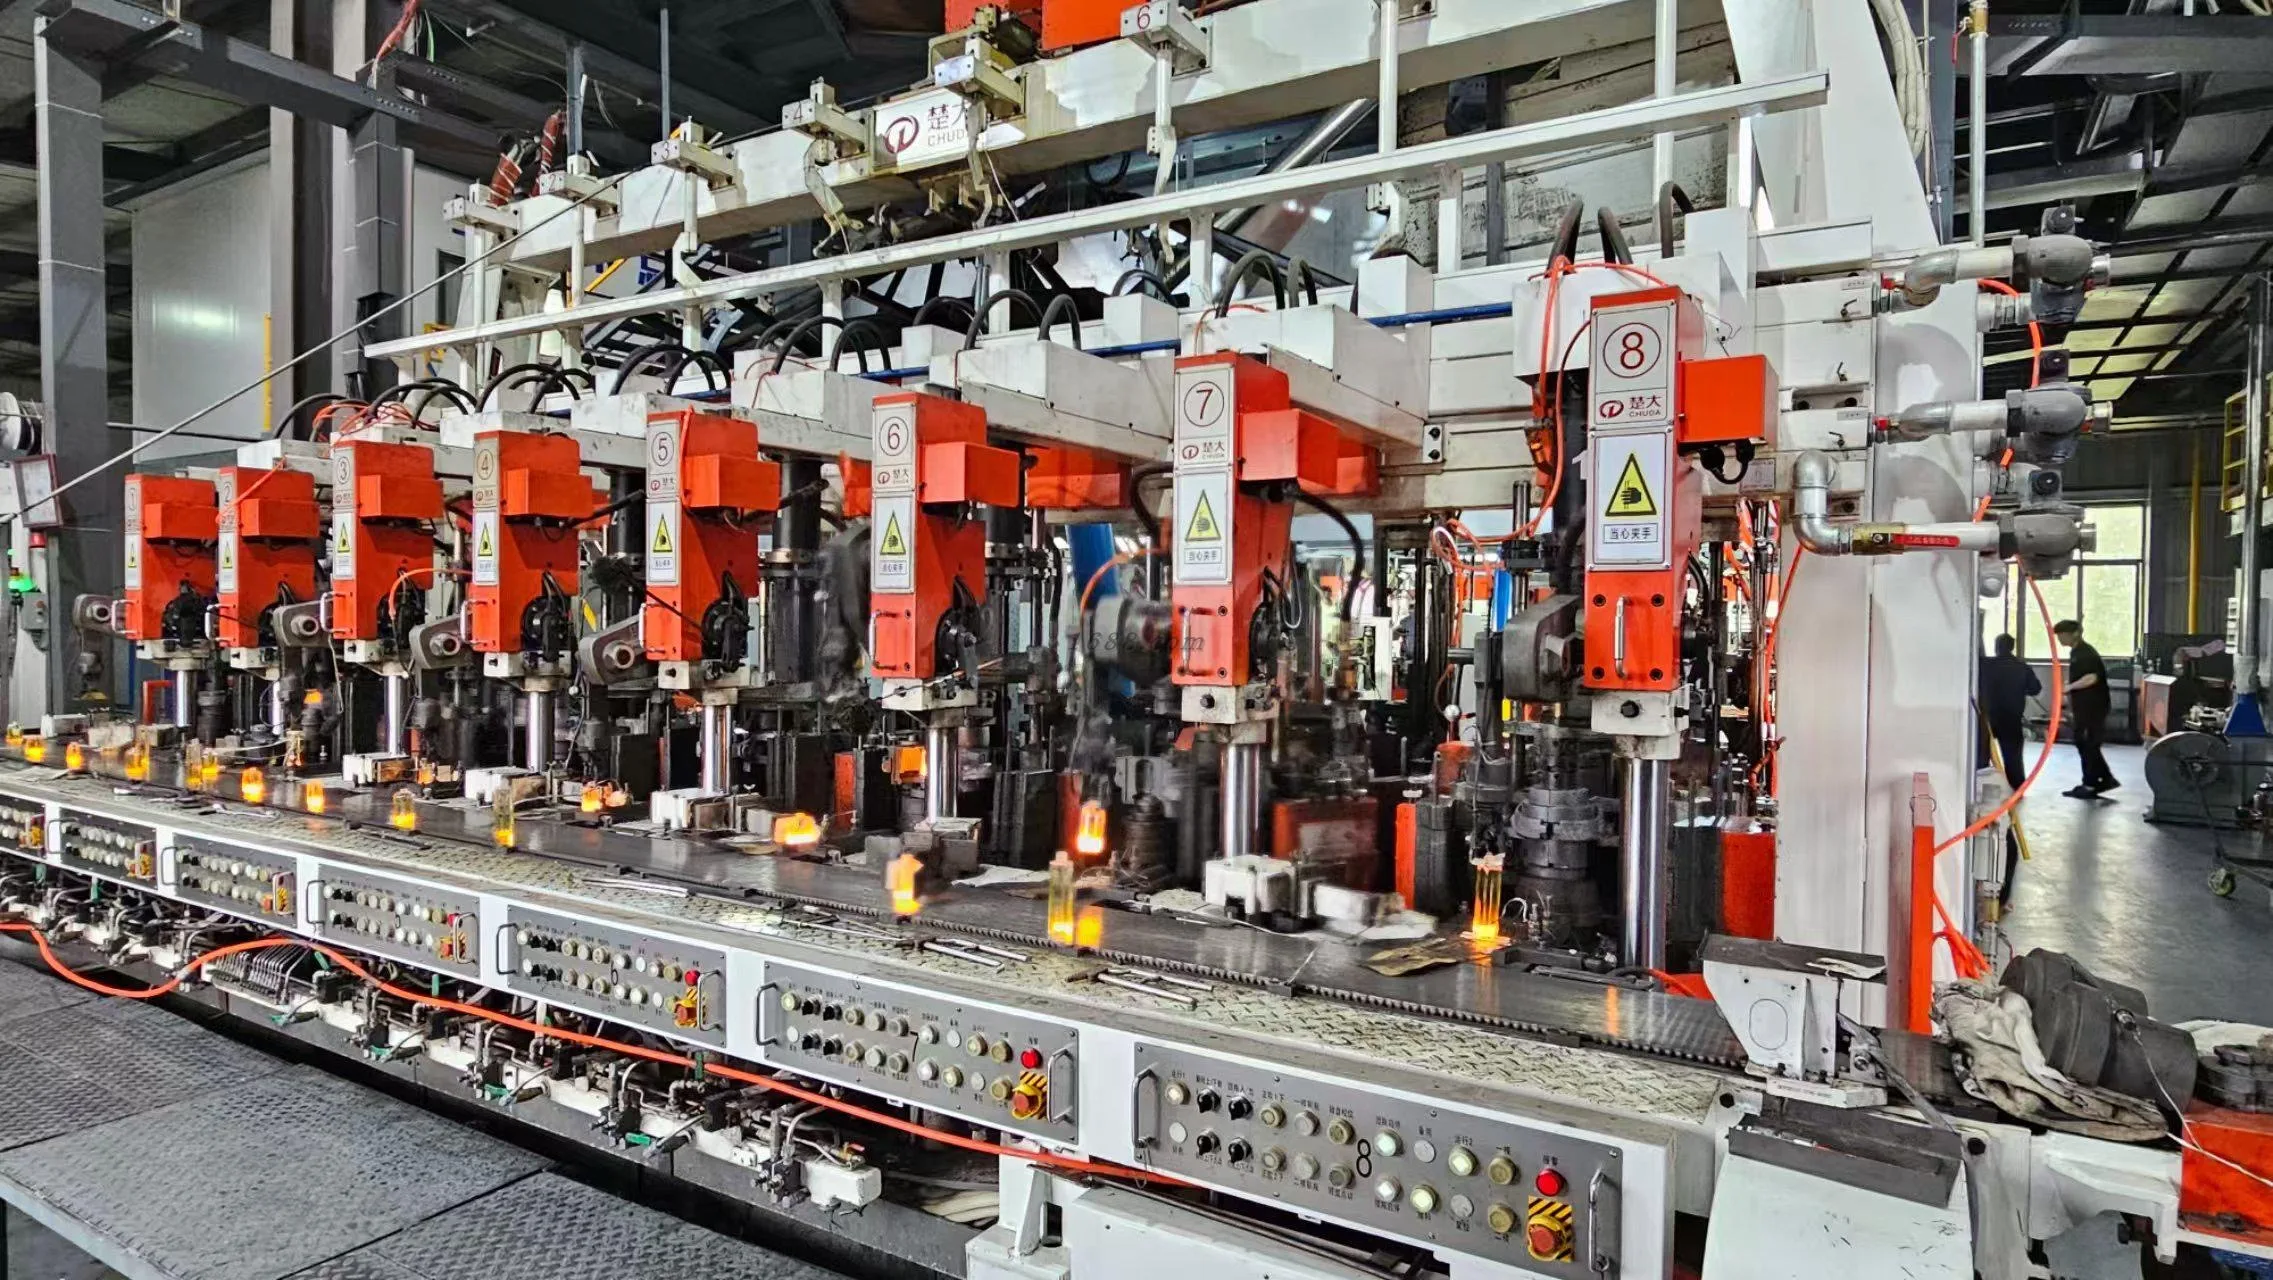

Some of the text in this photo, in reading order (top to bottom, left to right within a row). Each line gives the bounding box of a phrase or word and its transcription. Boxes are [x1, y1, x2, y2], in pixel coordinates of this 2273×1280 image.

[1136, 6, 1150, 30] 6
[793, 105, 803, 120] 4
[928, 129, 965, 147] CHUD
[661, 141, 670, 160] 3
[1619, 331, 1645, 370] 8
[1196, 388, 1213, 420] 7
[1629, 394, 1662, 410] 楚大
[887, 423, 901, 450] 6
[658, 438, 668, 461] 5
[340, 460, 347, 480] 3
[481, 453, 489, 473] 4
[1356, 1138, 1372, 1178] 8
